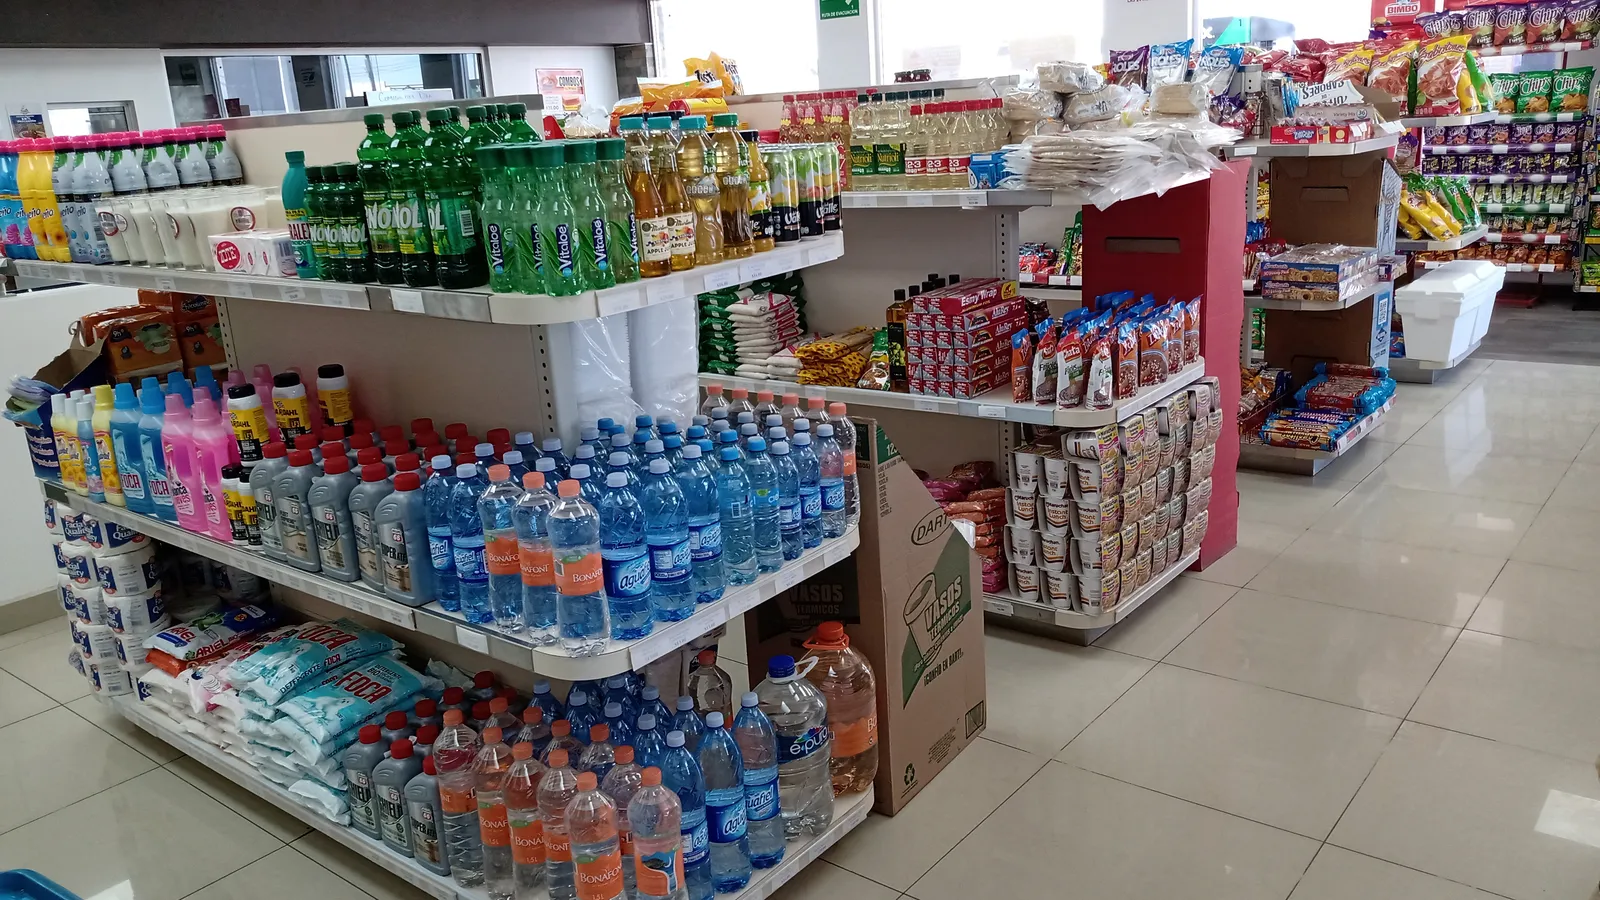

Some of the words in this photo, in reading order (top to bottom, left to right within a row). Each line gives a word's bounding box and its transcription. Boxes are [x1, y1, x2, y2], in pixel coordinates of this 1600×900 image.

[1387, 4, 1418, 14] BIMBO
[1112, 60, 1139, 73] ROLES
[1152, 54, 1182, 67] ROLES
[1200, 55, 1231, 68] ROLES
[558, 76, 580, 87] COMBOS
[1302, 80, 1344, 99] SABORES
[877, 151, 899, 163] Nutrioli
[490, 225, 504, 268] Vitaloe
[559, 225, 573, 271] Vitaloe
[594, 218, 607, 264] Vitaloe
[218, 247, 237, 264] ZOTE
[981, 288, 997, 299] Wrap
[790, 584, 844, 602] VASOS
[924, 575, 962, 633] VASOS
[196, 639, 230, 658] ARIEL
[335, 671, 392, 704] FOCA
